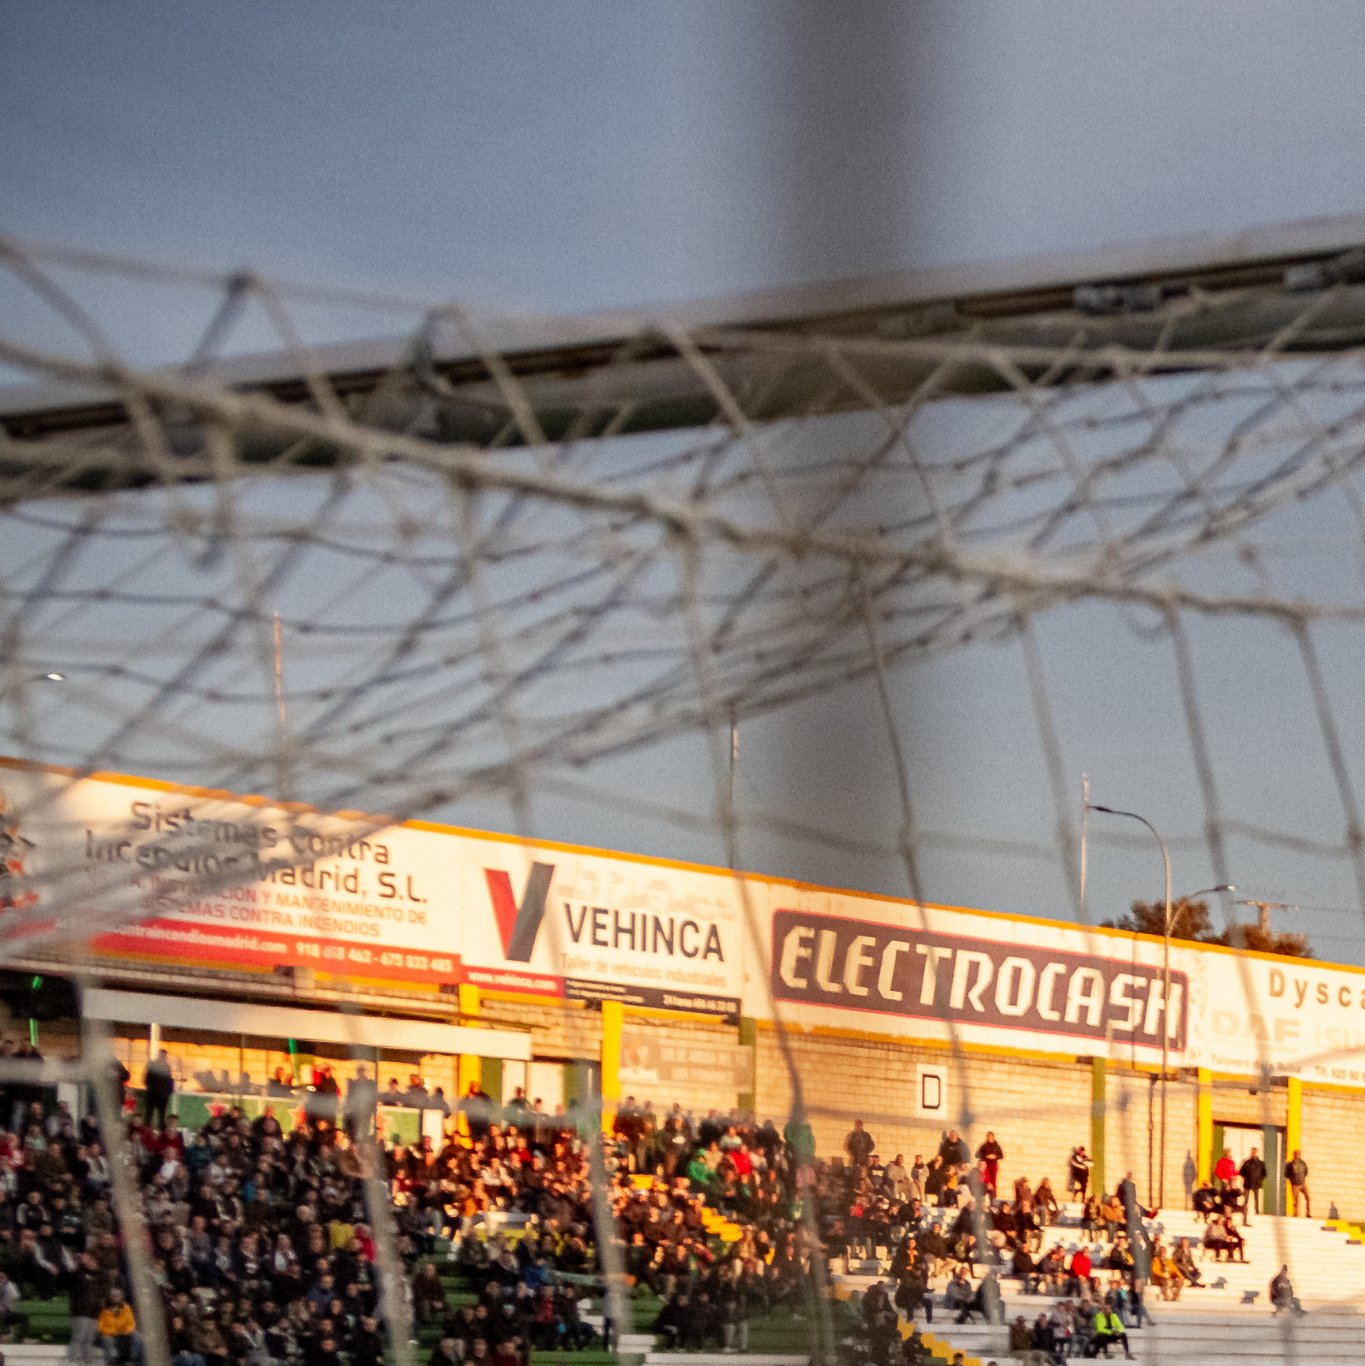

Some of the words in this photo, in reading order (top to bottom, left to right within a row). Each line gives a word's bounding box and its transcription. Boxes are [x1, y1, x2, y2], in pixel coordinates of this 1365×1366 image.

[564, 902, 725, 963] VEHINCA
[779, 924, 1182, 1040] ELECTROCASH
[921, 1073, 941, 1110] D
